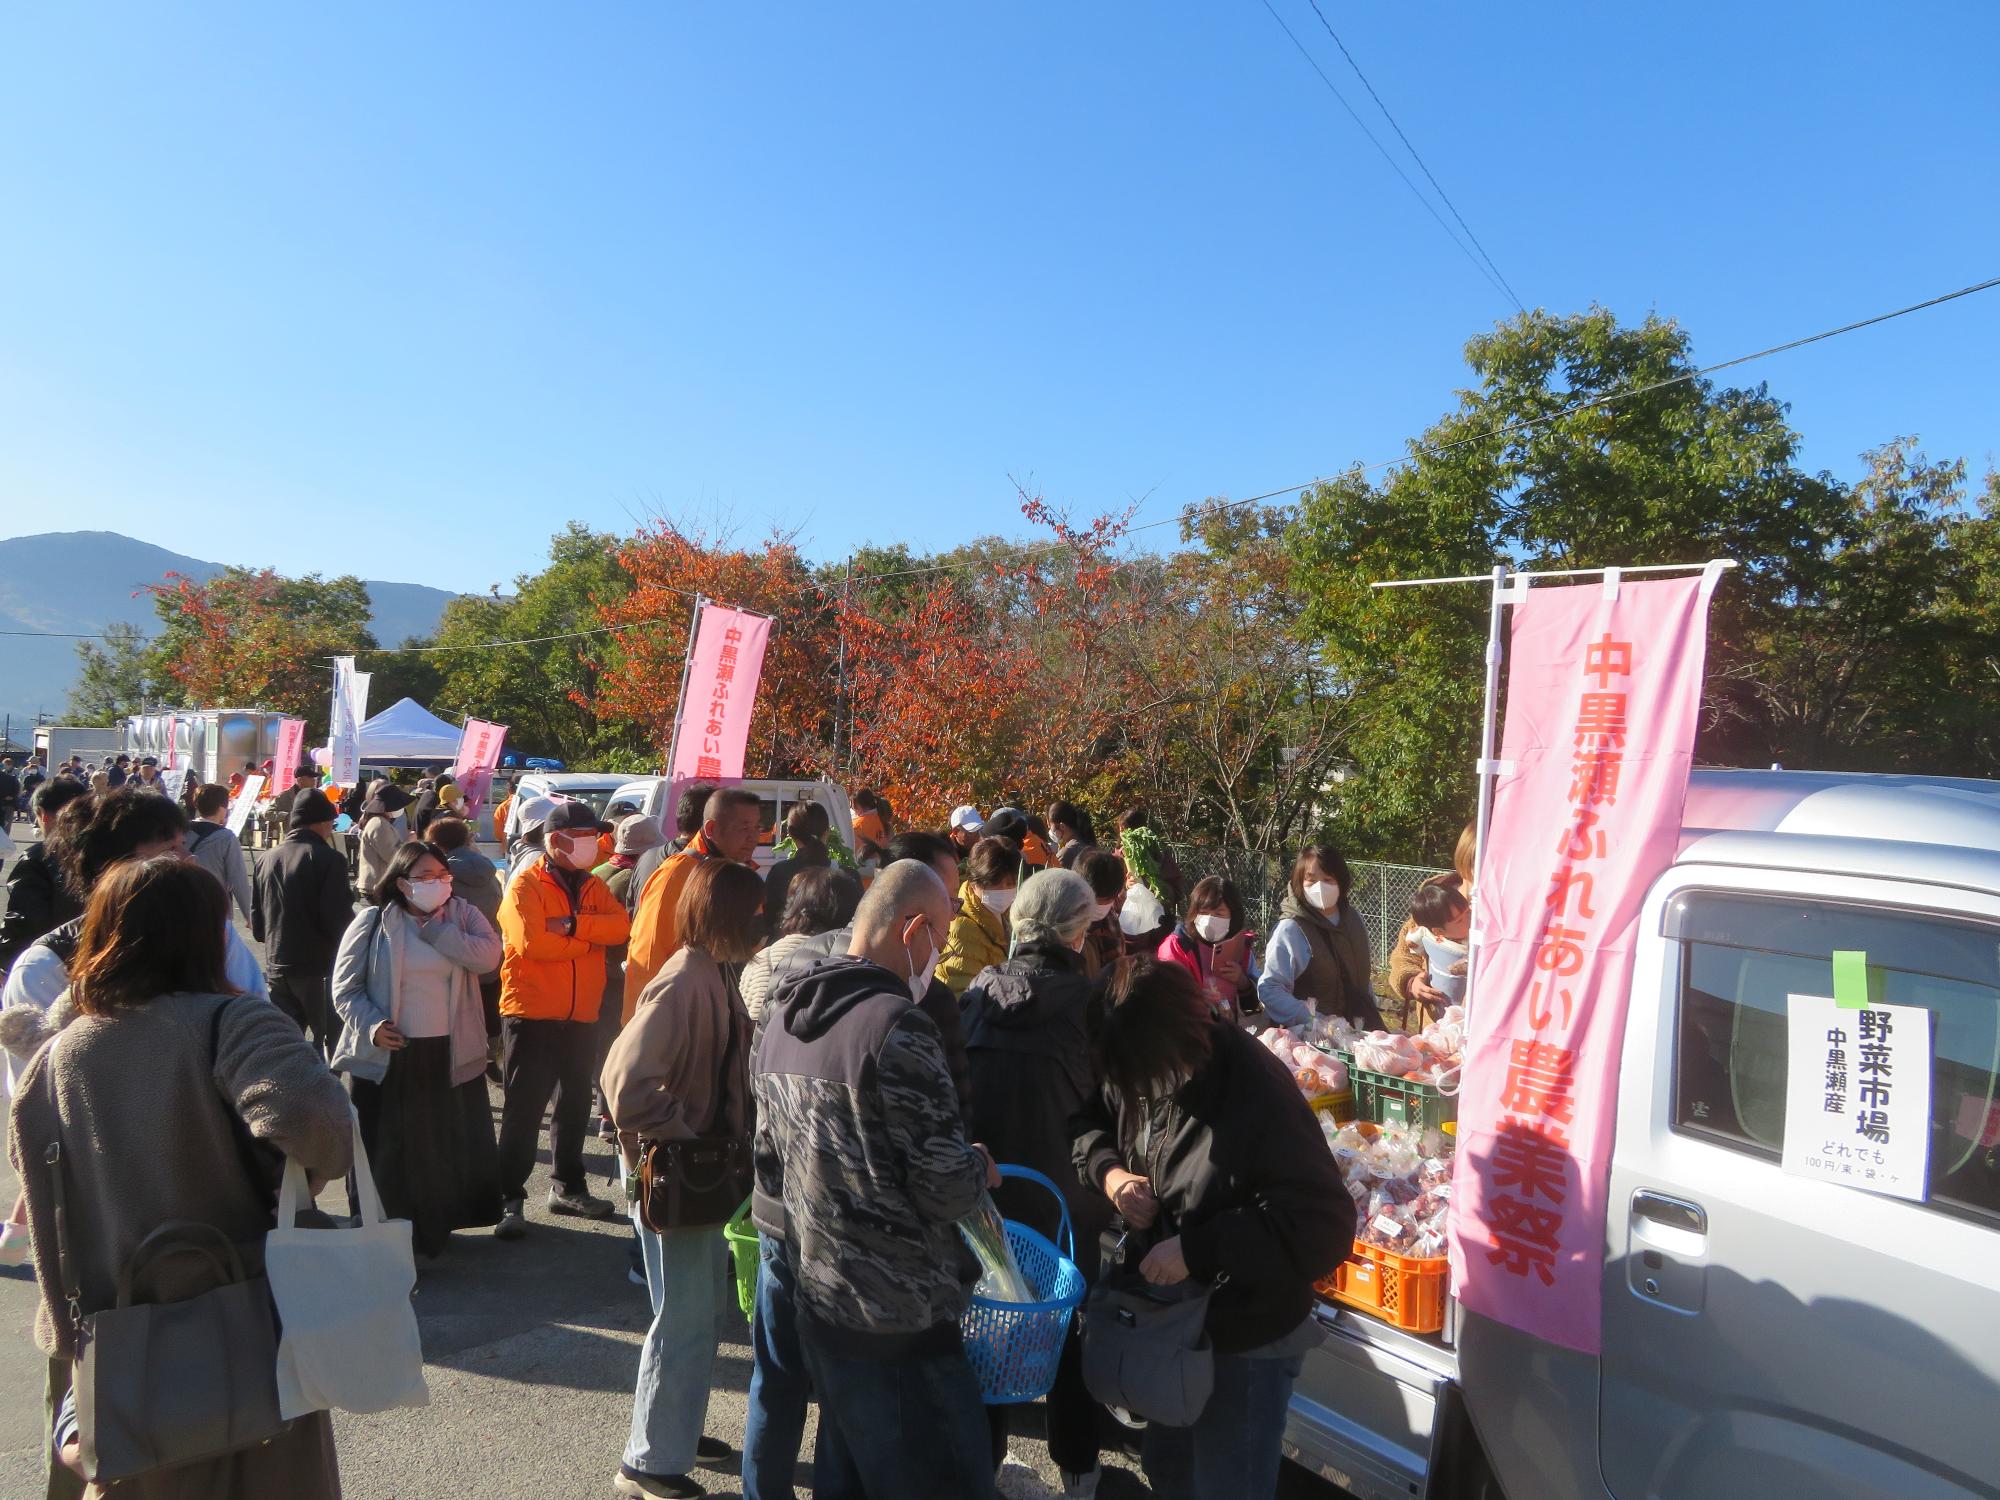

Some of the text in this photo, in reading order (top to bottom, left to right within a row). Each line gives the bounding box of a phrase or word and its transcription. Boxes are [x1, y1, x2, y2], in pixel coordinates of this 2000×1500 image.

[1486, 633, 1632, 1287] 中黒瀬ふれあい農業祭
[1824, 1027, 1847, 1114] 中黒瀬産
[1856, 1009, 1893, 1145] 野菜市場
[1822, 1140, 1885, 1165] どれでも
